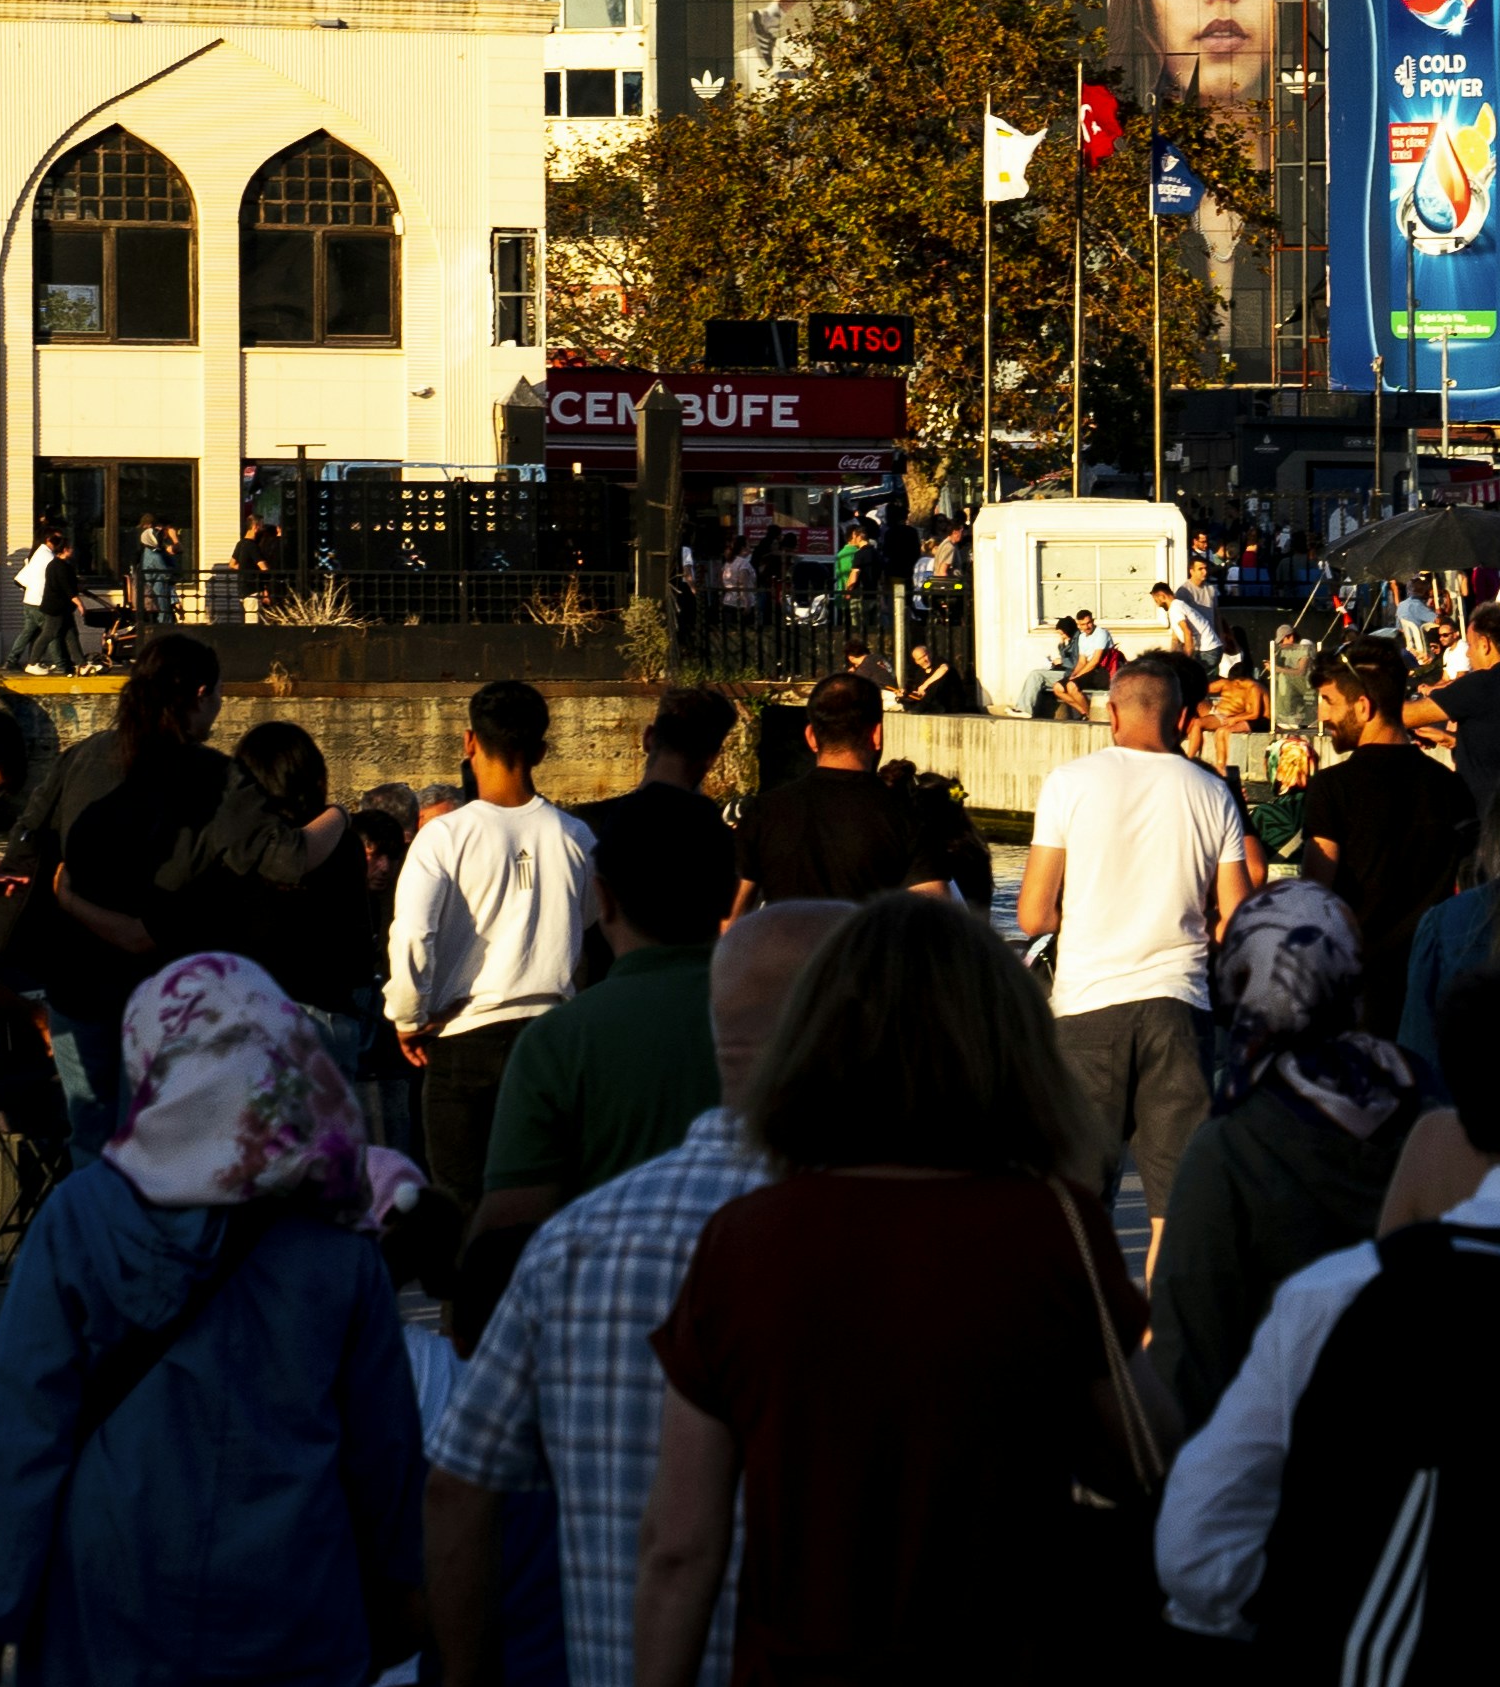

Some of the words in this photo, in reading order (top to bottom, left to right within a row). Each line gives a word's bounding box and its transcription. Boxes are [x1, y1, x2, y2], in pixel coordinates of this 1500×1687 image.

[1419, 54, 1467, 74] COLD
[1420, 78, 1483, 98] POWER
[681, 384, 800, 428] BÜFE
[838, 454, 882, 470] Coca-Cola
